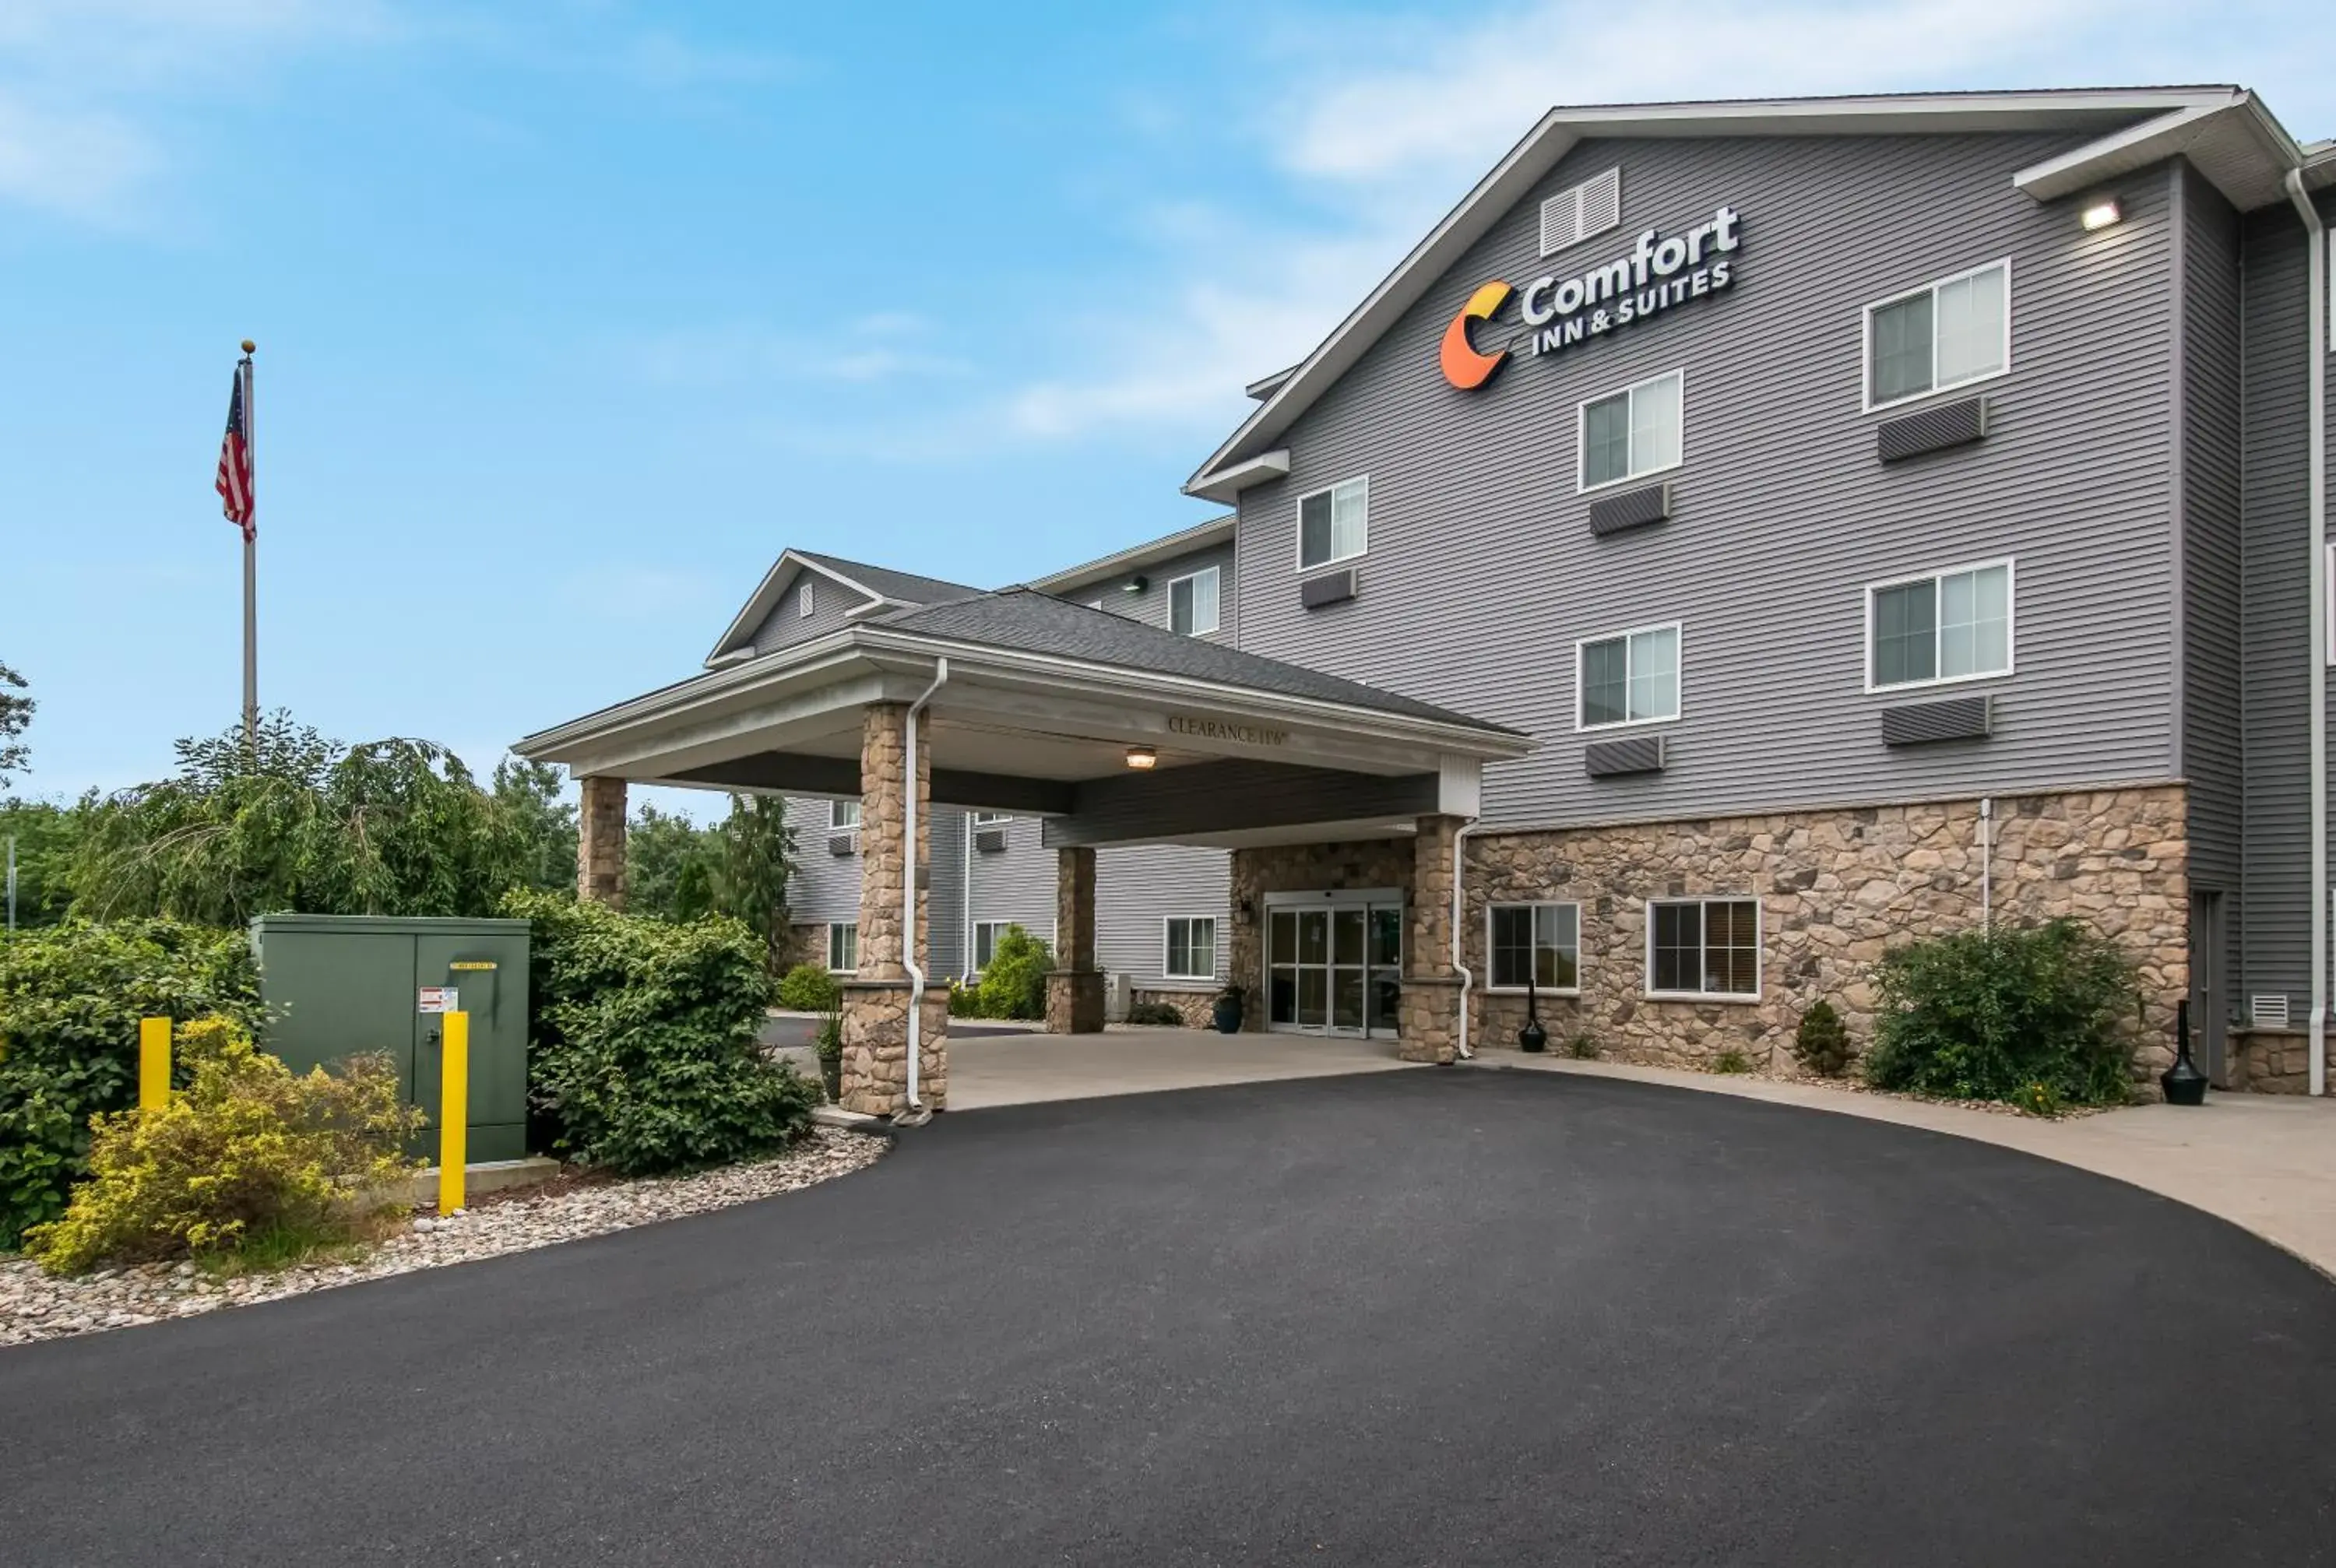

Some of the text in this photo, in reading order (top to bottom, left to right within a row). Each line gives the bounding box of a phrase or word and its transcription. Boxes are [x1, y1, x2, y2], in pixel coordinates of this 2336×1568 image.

[1521, 205, 1740, 326] Comfort
[1532, 261, 1730, 356] INN & SUITES
[1168, 716, 1258, 743] CLEARANCE
